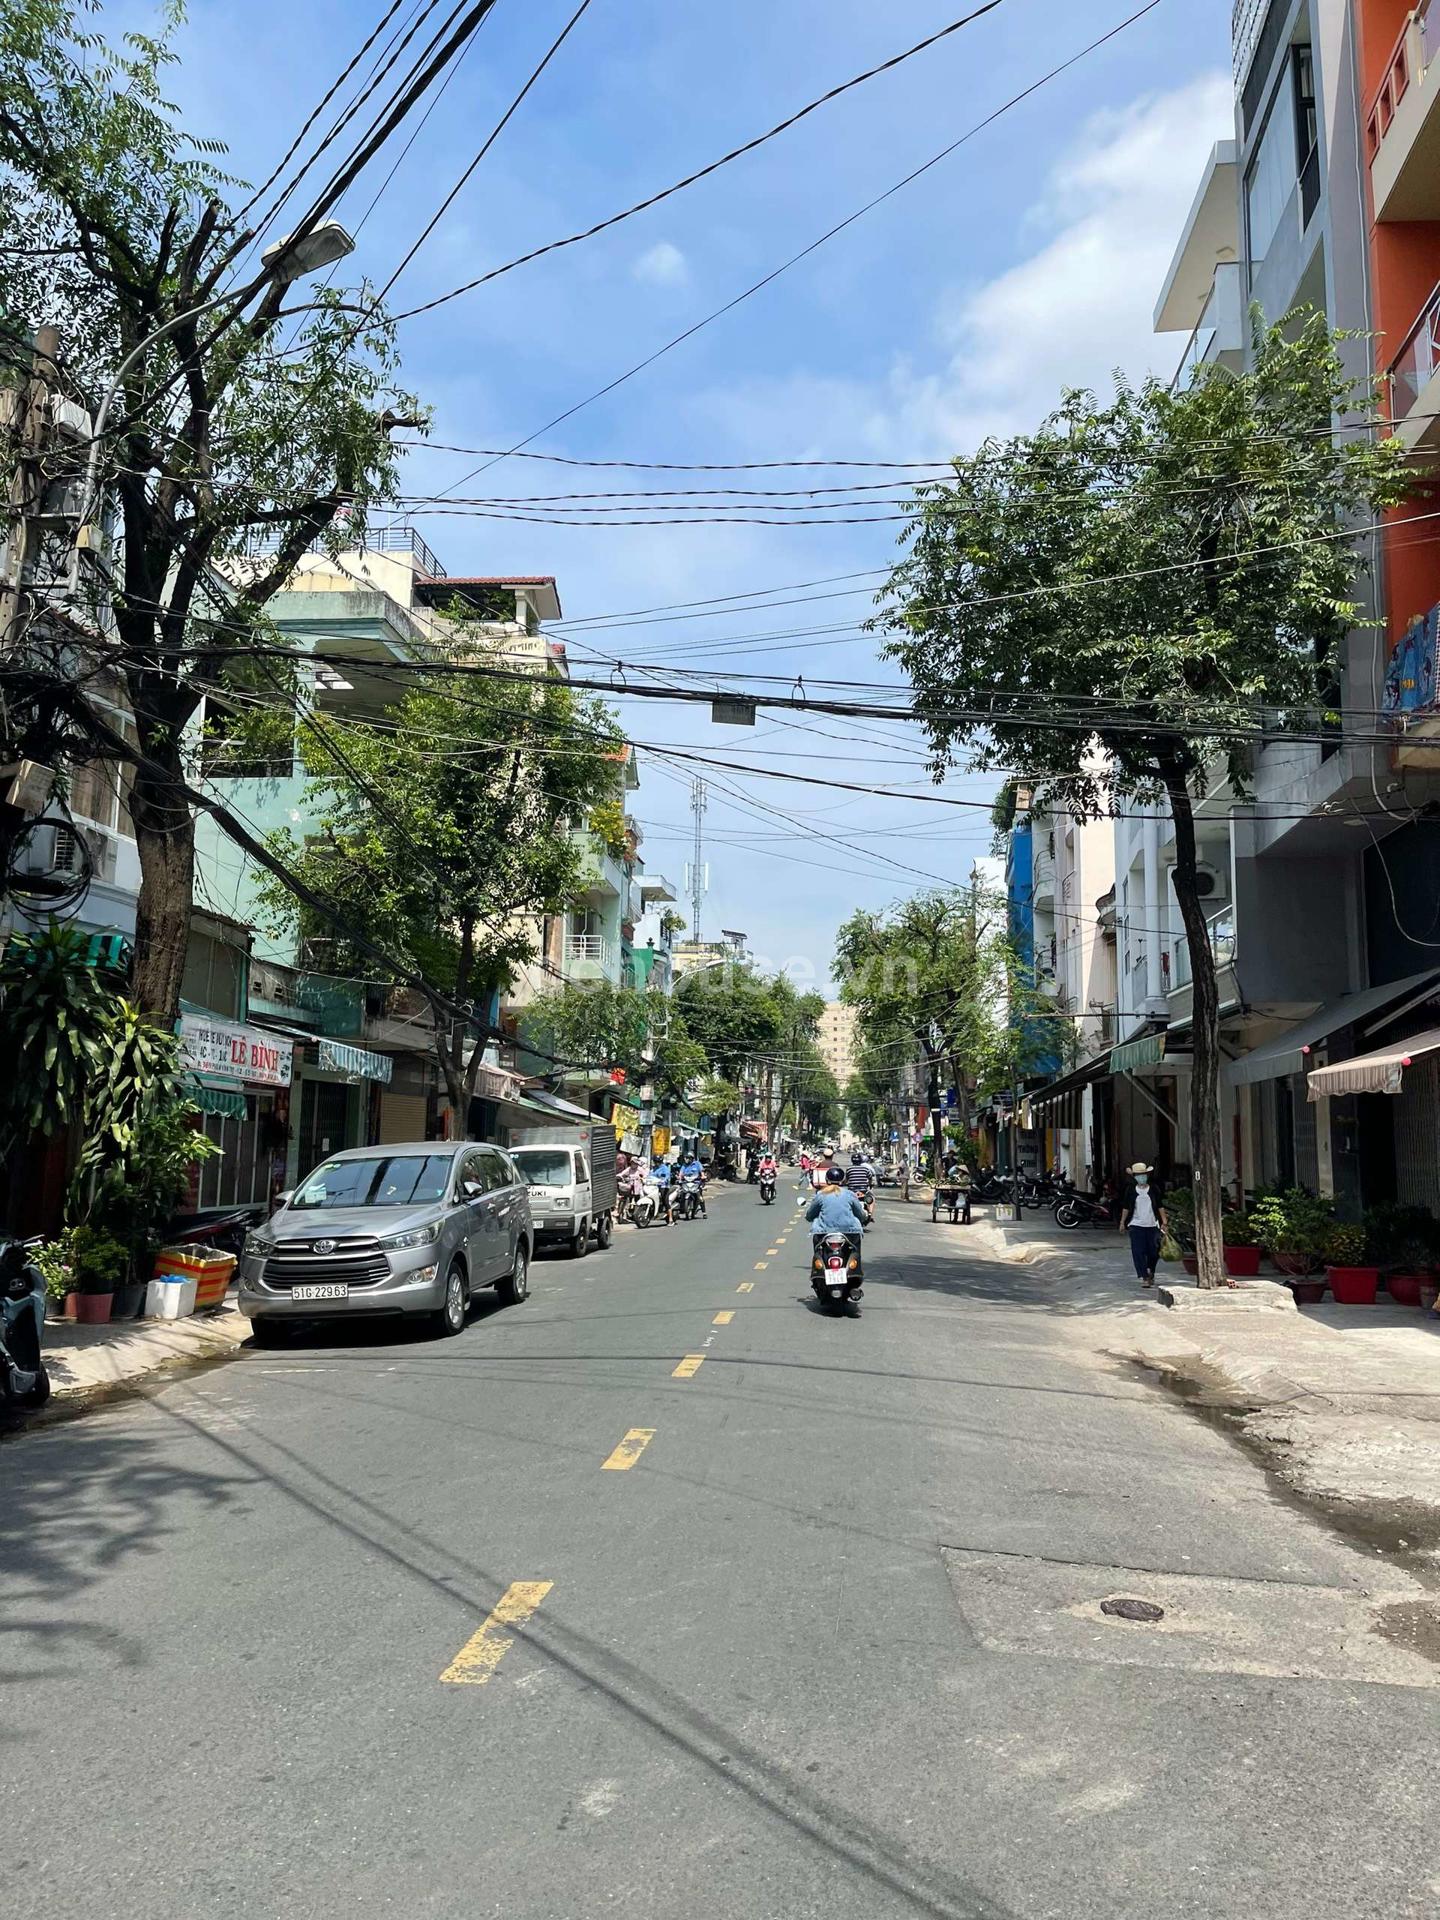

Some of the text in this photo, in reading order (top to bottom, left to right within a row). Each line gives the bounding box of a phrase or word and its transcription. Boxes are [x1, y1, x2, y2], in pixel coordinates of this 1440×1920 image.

[231, 1035, 247, 1064] LÊ
[250, 1040, 280, 1071] BÌNH
[294, 1287, 312, 1299] 51G
